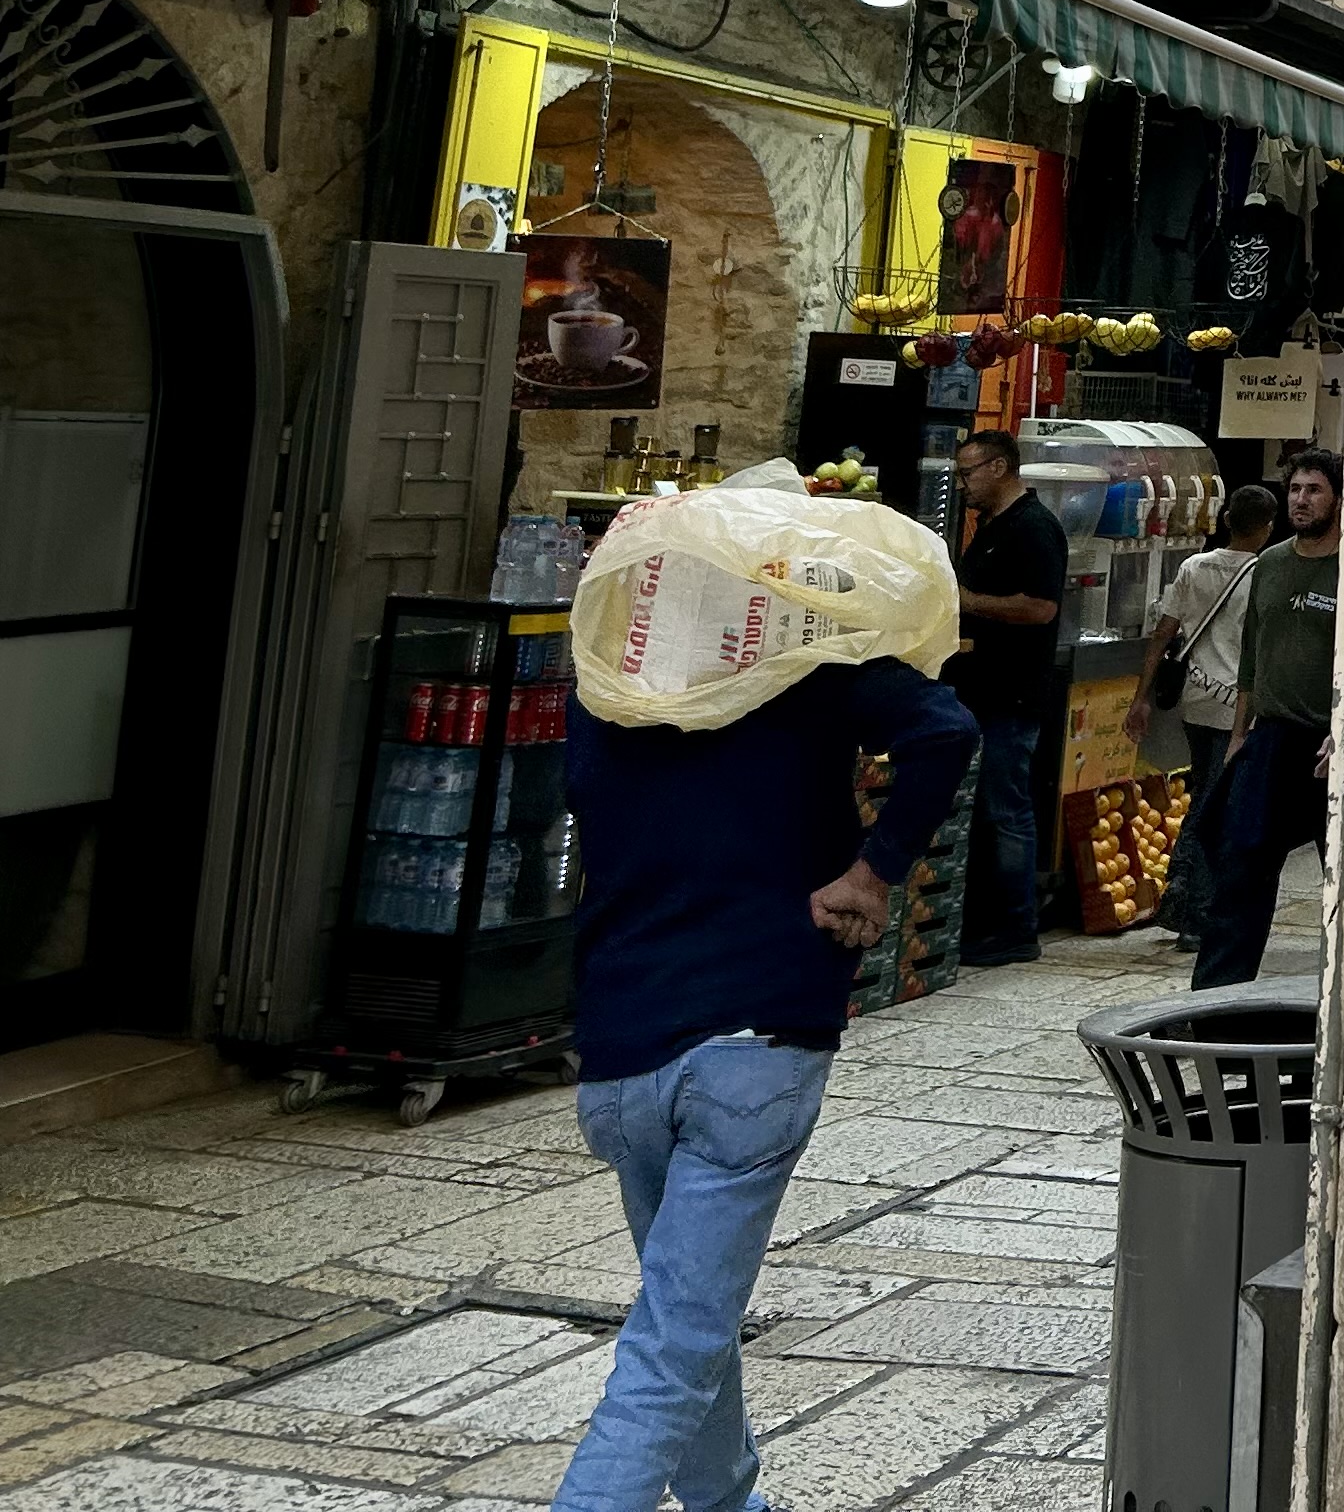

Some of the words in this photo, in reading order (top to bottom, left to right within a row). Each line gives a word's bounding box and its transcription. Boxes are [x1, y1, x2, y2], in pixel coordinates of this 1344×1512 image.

[1236, 390, 1255, 402] WHY
[1256, 391, 1289, 402] ALWAYS
[1289, 391, 1308, 403] ME?
